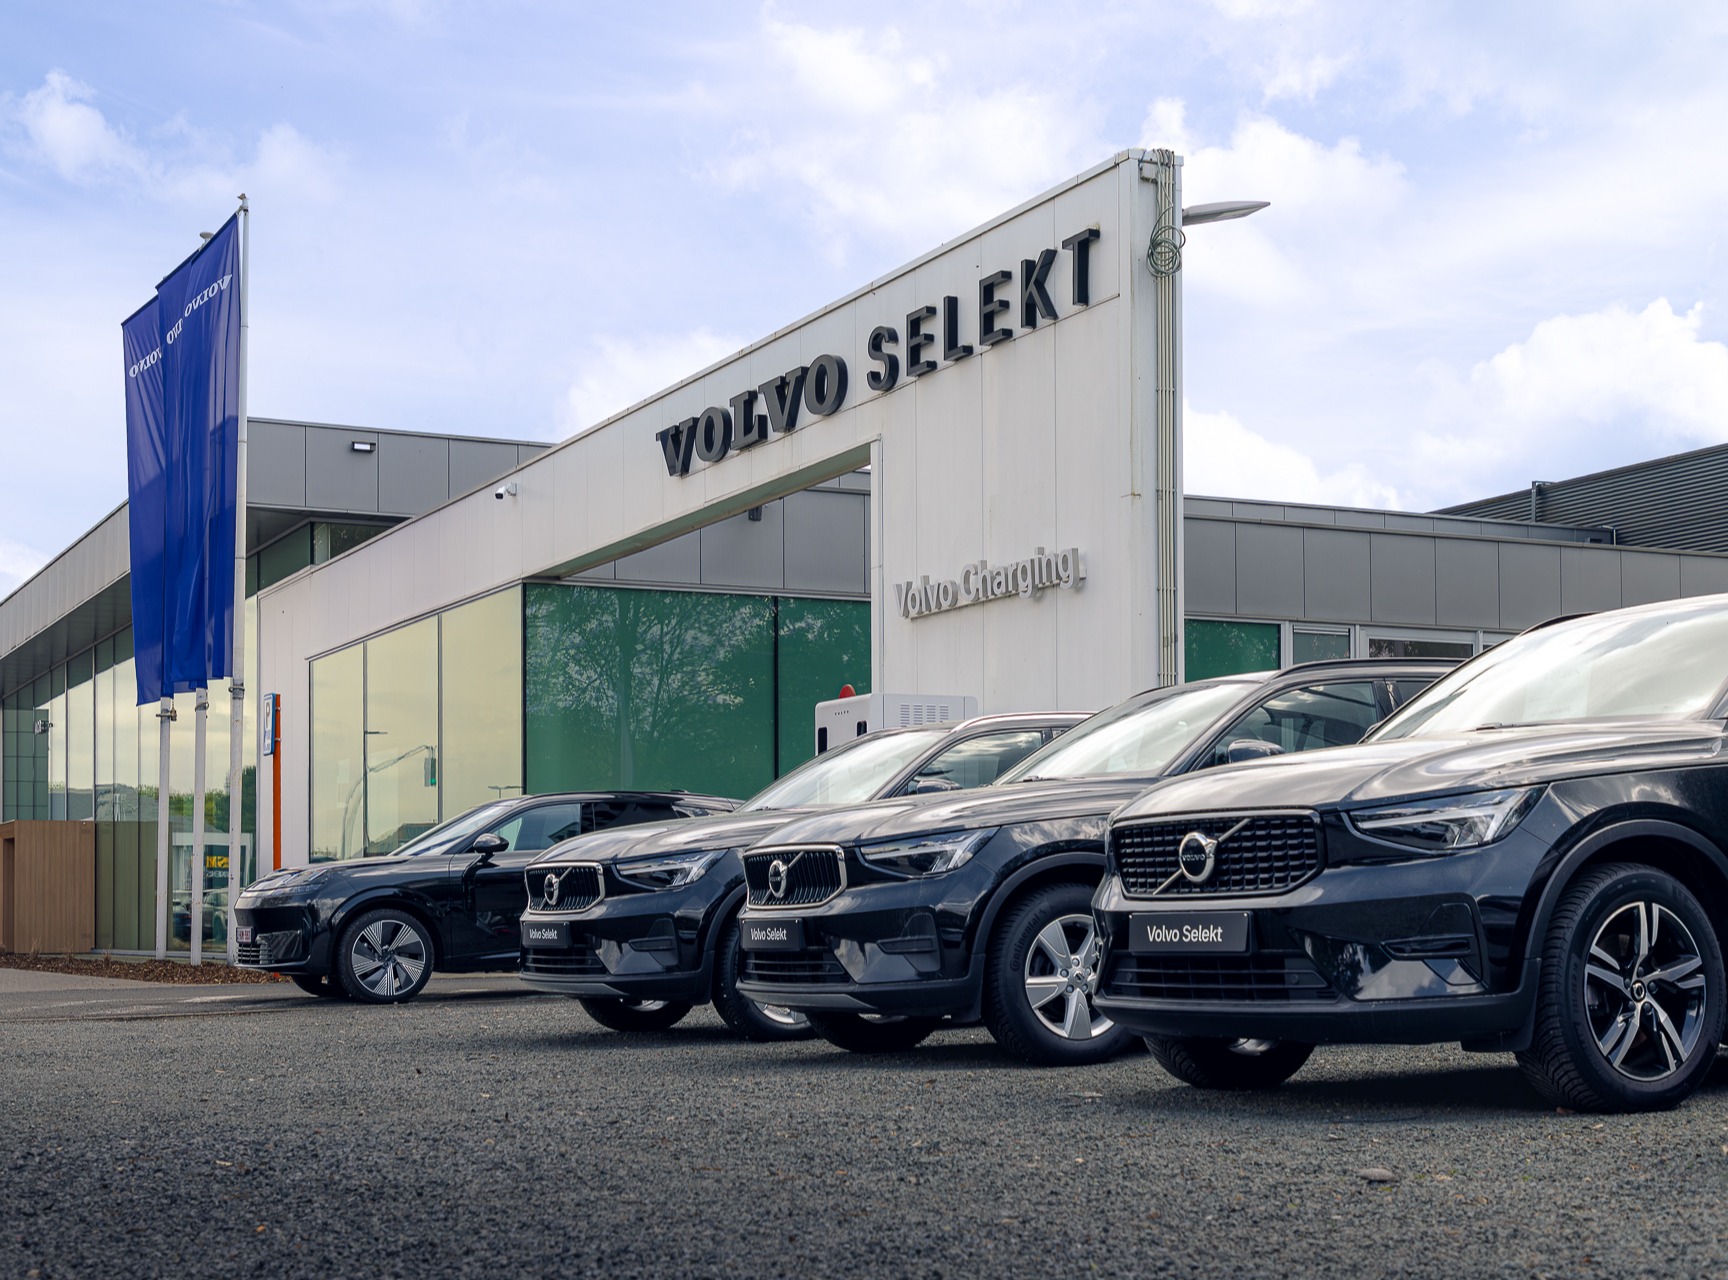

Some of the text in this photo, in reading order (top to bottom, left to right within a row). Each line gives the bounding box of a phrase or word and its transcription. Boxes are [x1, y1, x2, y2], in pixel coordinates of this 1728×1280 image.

[655, 228, 1100, 478] VOLVO SELEKT
[893, 546, 1079, 619] Volvo Charging
[529, 928, 558, 940] Volvo Selekt
[750, 927, 787, 940] Volvo Selekt
[1146, 924, 1223, 942] Volvo Selekt
